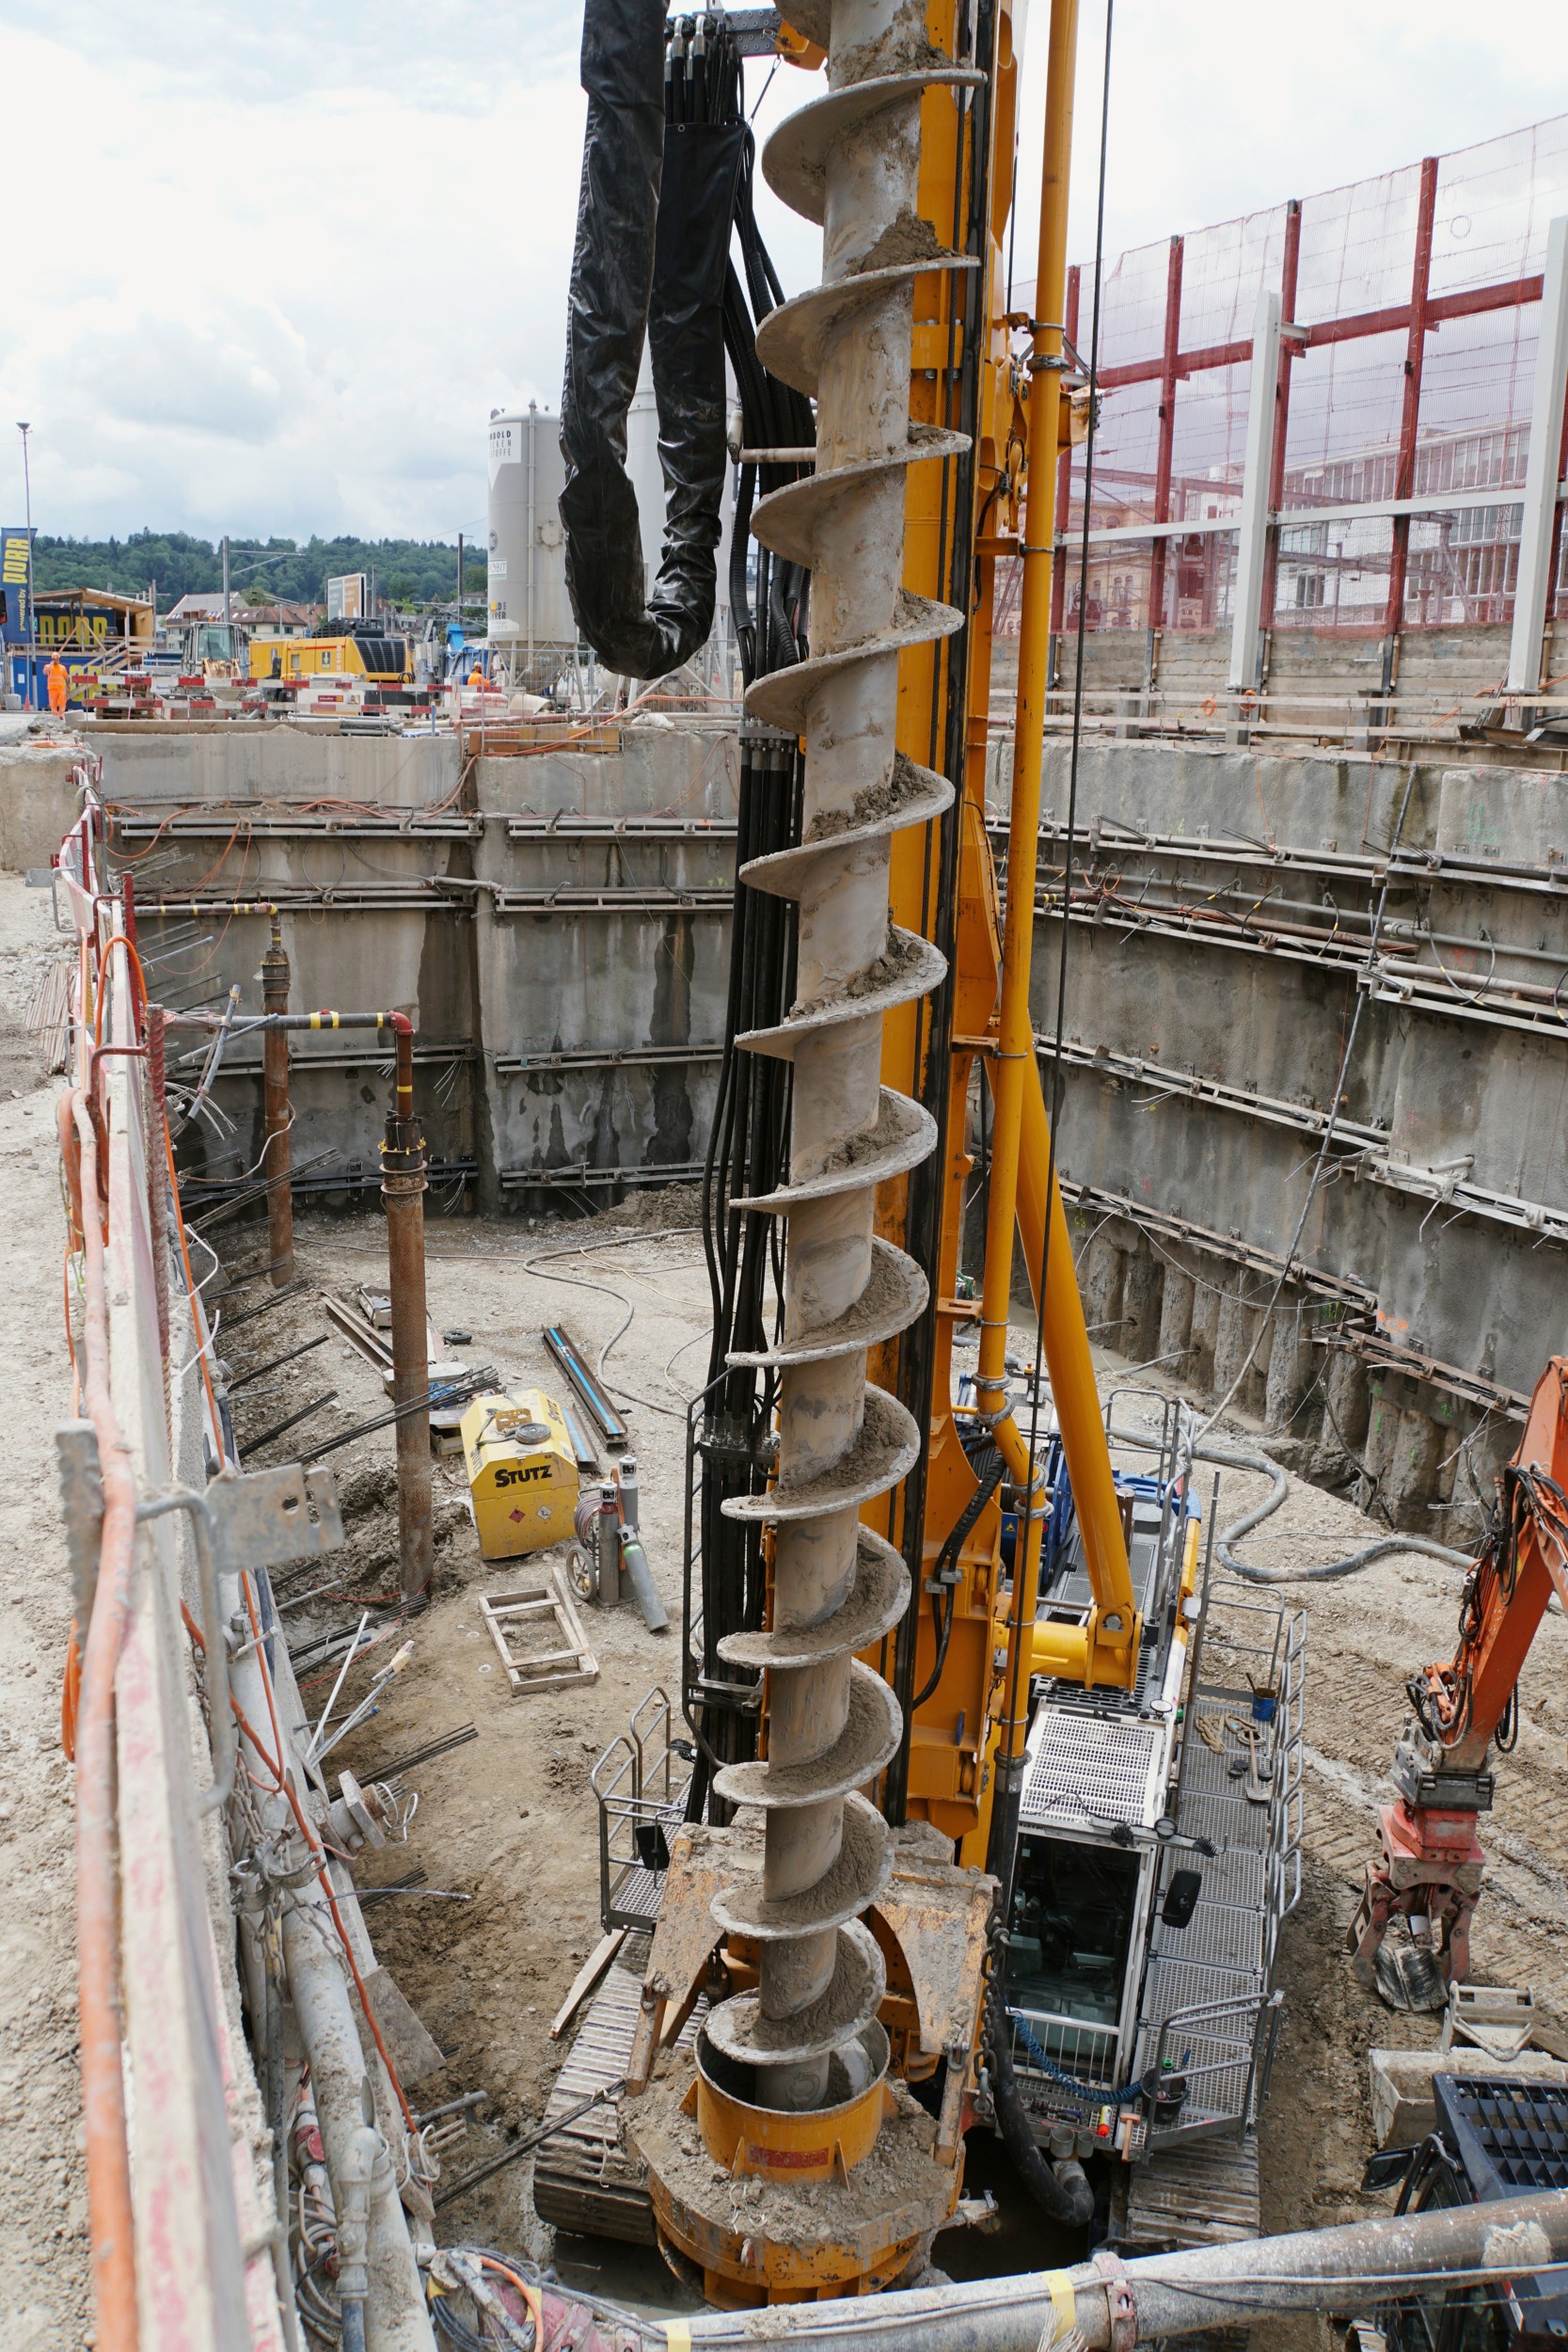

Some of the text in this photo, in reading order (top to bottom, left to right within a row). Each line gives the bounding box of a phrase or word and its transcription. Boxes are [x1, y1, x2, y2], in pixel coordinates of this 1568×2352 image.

[3, 538, 29, 583] PORR
[18, 588, 25, 598] by
[494, 1464, 553, 1488] STUTZ
